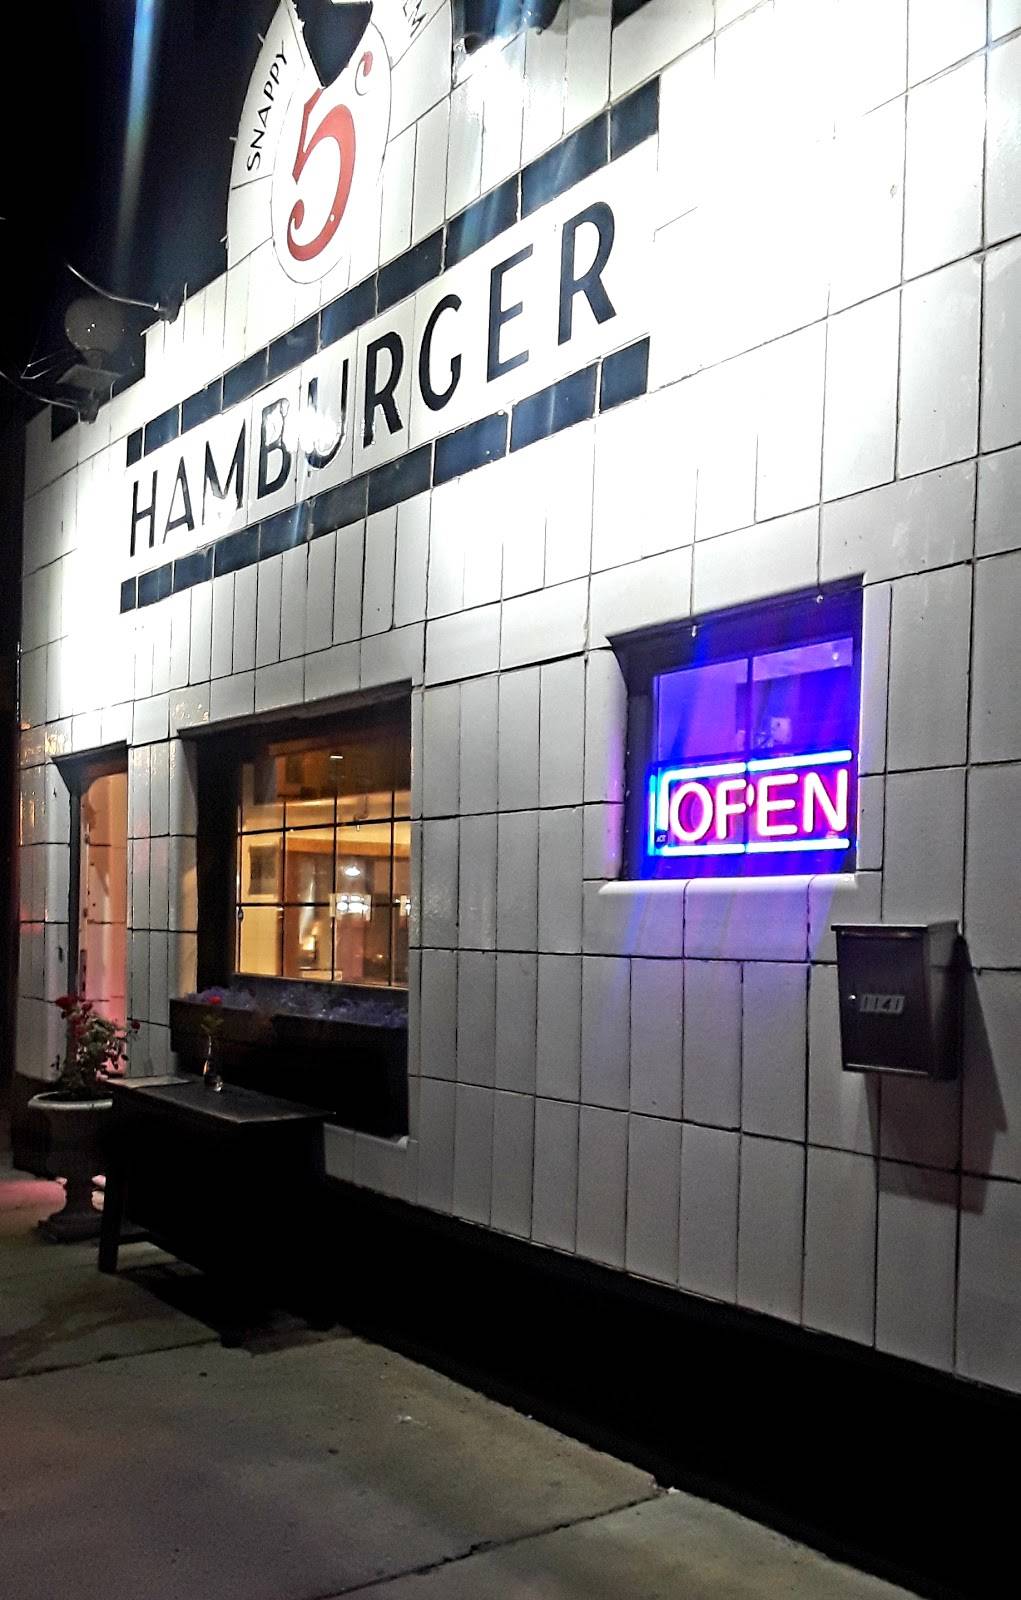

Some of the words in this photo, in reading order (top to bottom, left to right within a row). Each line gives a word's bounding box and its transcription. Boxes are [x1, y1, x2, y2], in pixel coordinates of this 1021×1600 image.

[246, 40, 288, 171] SNAPPY
[129, 201, 617, 557] HAMBURGER
[669, 768, 849, 842] OPEN
